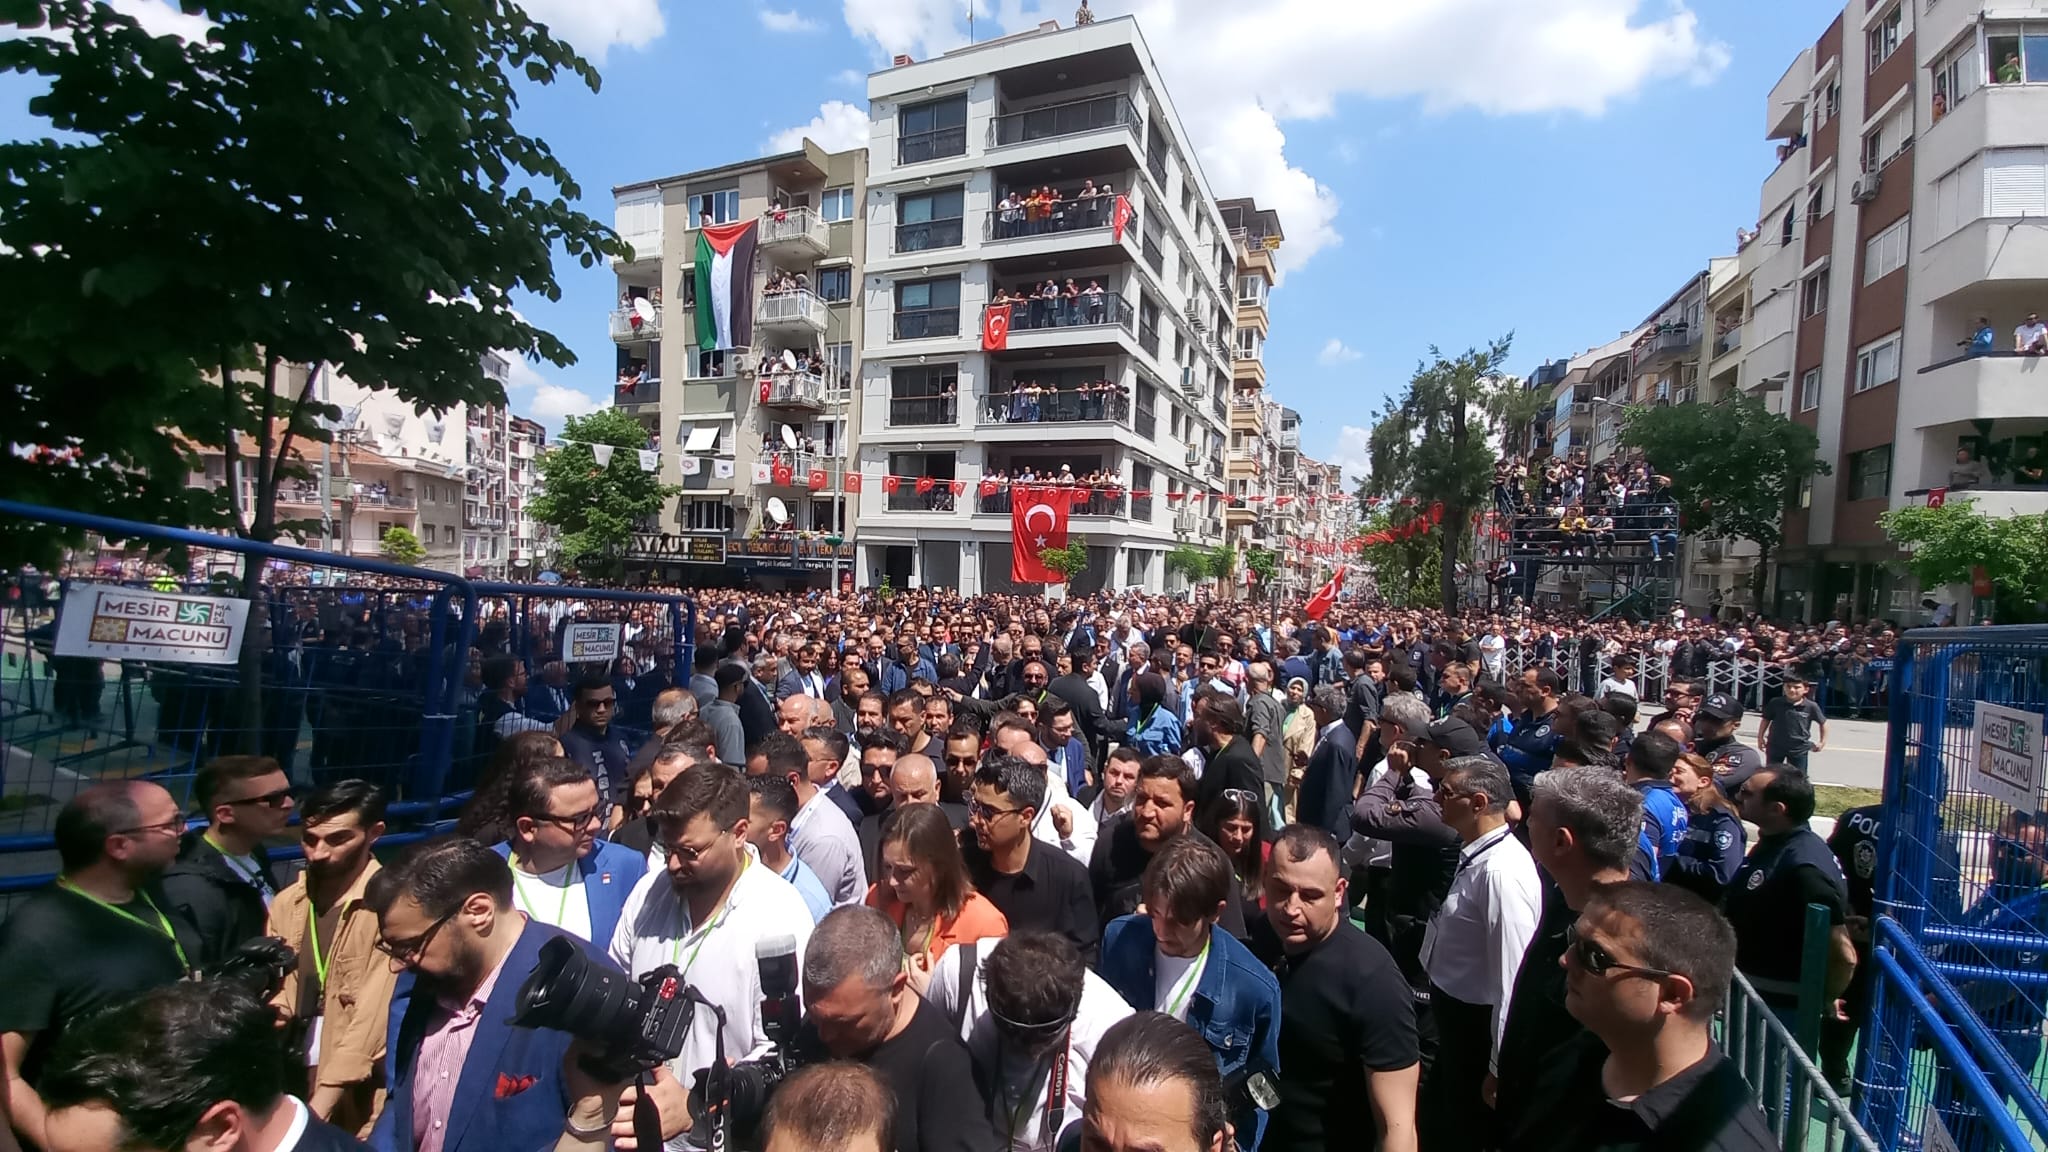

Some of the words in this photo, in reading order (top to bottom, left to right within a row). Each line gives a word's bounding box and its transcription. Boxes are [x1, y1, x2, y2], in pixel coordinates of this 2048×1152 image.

[630, 536, 692, 553] AYKUT
[104, 600, 170, 618] MESİR
[132, 626, 226, 644] MACUNU
[576, 630, 597, 640] MESİR
[584, 644, 613, 653] MACUNU
[1984, 722, 2008, 742] MESİR
[1993, 757, 2030, 782] MACUNU
[1848, 813, 1880, 840] POL
[1054, 1052, 1066, 1097] Canon
